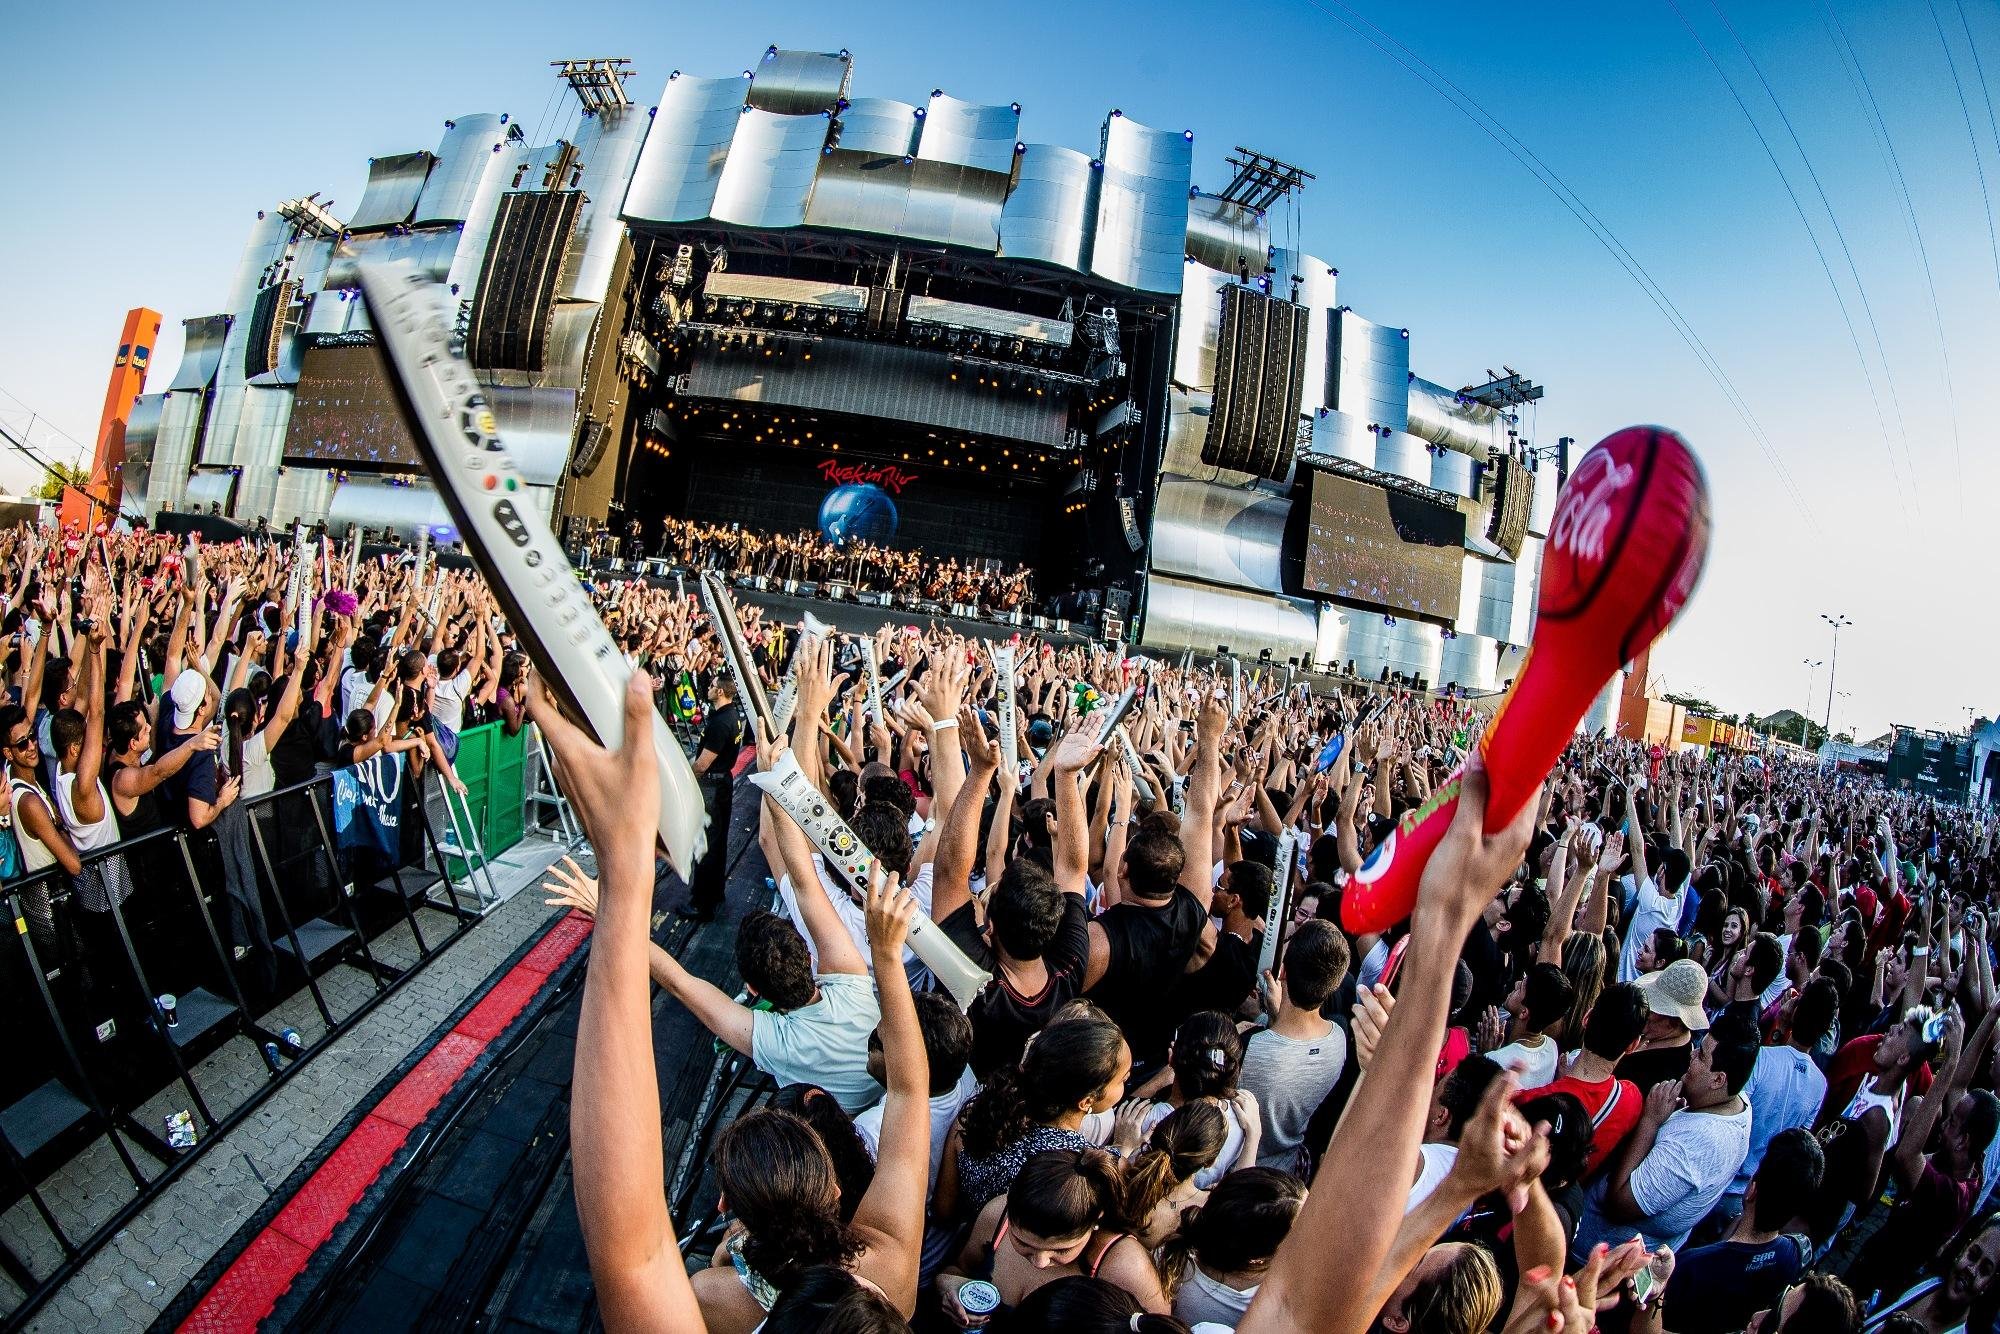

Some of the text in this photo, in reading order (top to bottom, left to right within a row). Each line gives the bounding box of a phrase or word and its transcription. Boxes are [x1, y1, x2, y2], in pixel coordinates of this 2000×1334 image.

[133, 355, 147, 367] Itaú
[817, 459, 919, 494] Rock in Rio
